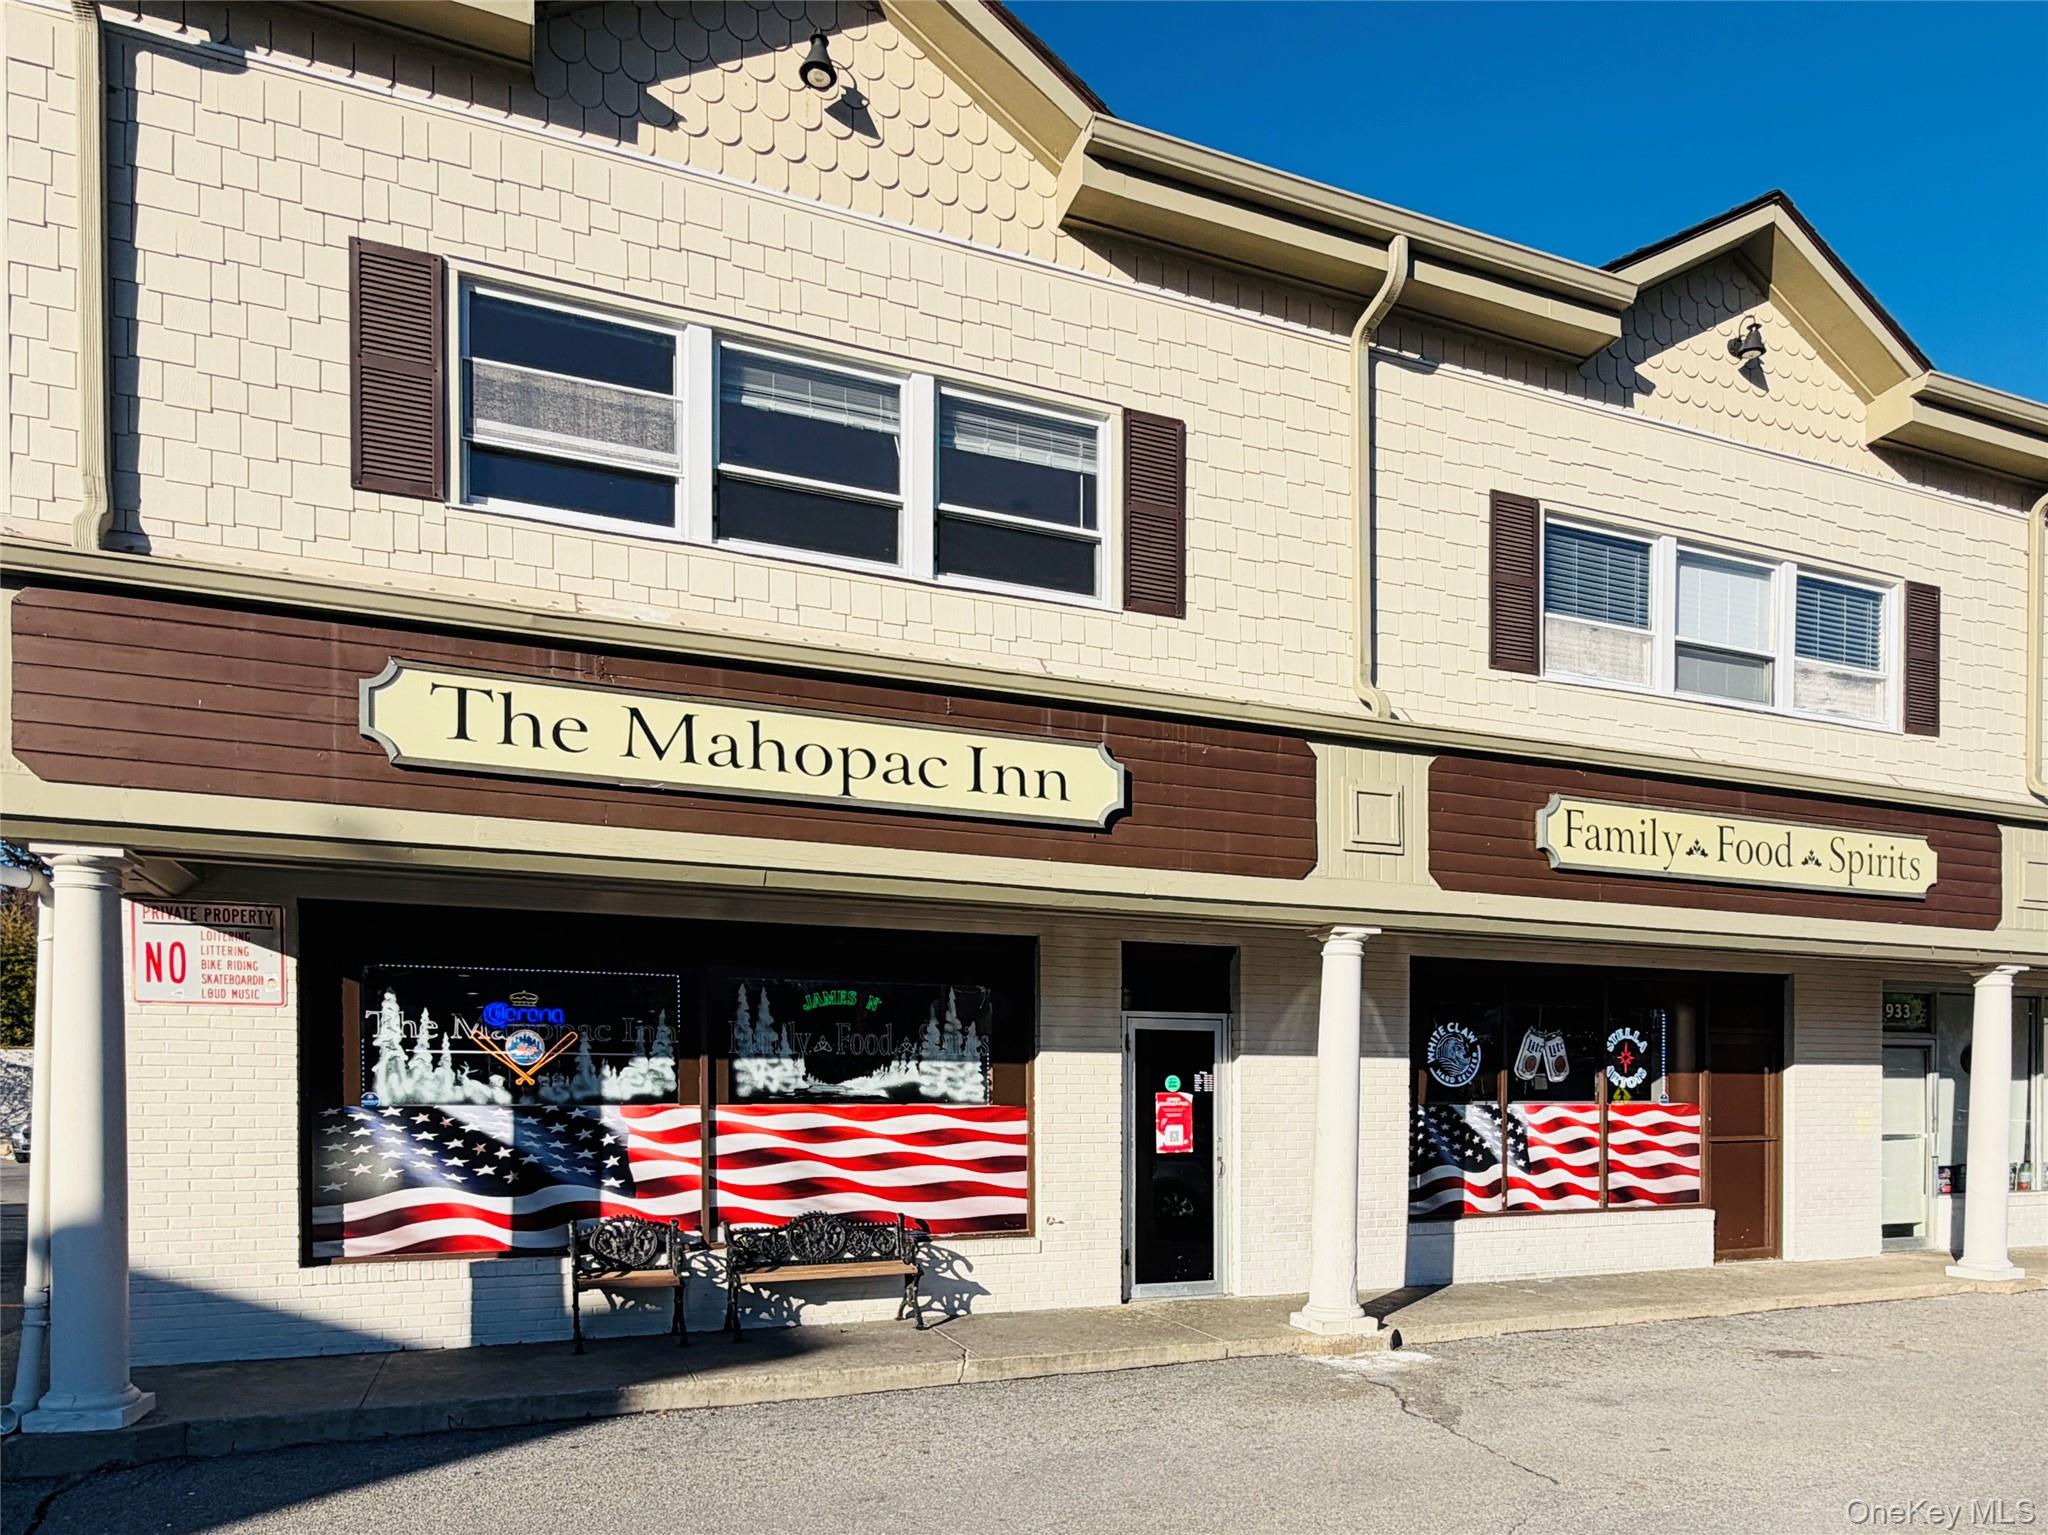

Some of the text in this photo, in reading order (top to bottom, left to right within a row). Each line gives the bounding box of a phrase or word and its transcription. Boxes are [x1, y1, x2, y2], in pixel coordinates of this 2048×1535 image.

[431, 681, 1071, 802] The Mahopac Inn
[1563, 809, 1921, 886] Family Food Spirits
[142, 905, 274, 924] PRIVATE PROPERTY
[200, 930, 250, 942] LOITERING
[200, 944, 250, 957] LITTERING
[145, 941, 187, 984] NO
[201, 959, 258, 971] BIKE RIDING
[201, 973, 264, 985] SKATEBOARDI
[201, 988, 260, 999] LOUD MUSIC
[803, 989, 858, 1012] JAMES
[483, 1002, 565, 1029] Corona
[1885, 1003, 1911, 1018] 933
[1427, 1022, 1478, 1064] WHITE CLAW
[1606, 1027, 1648, 1053] STELLA
[1435, 1069, 1456, 1084] HARD
